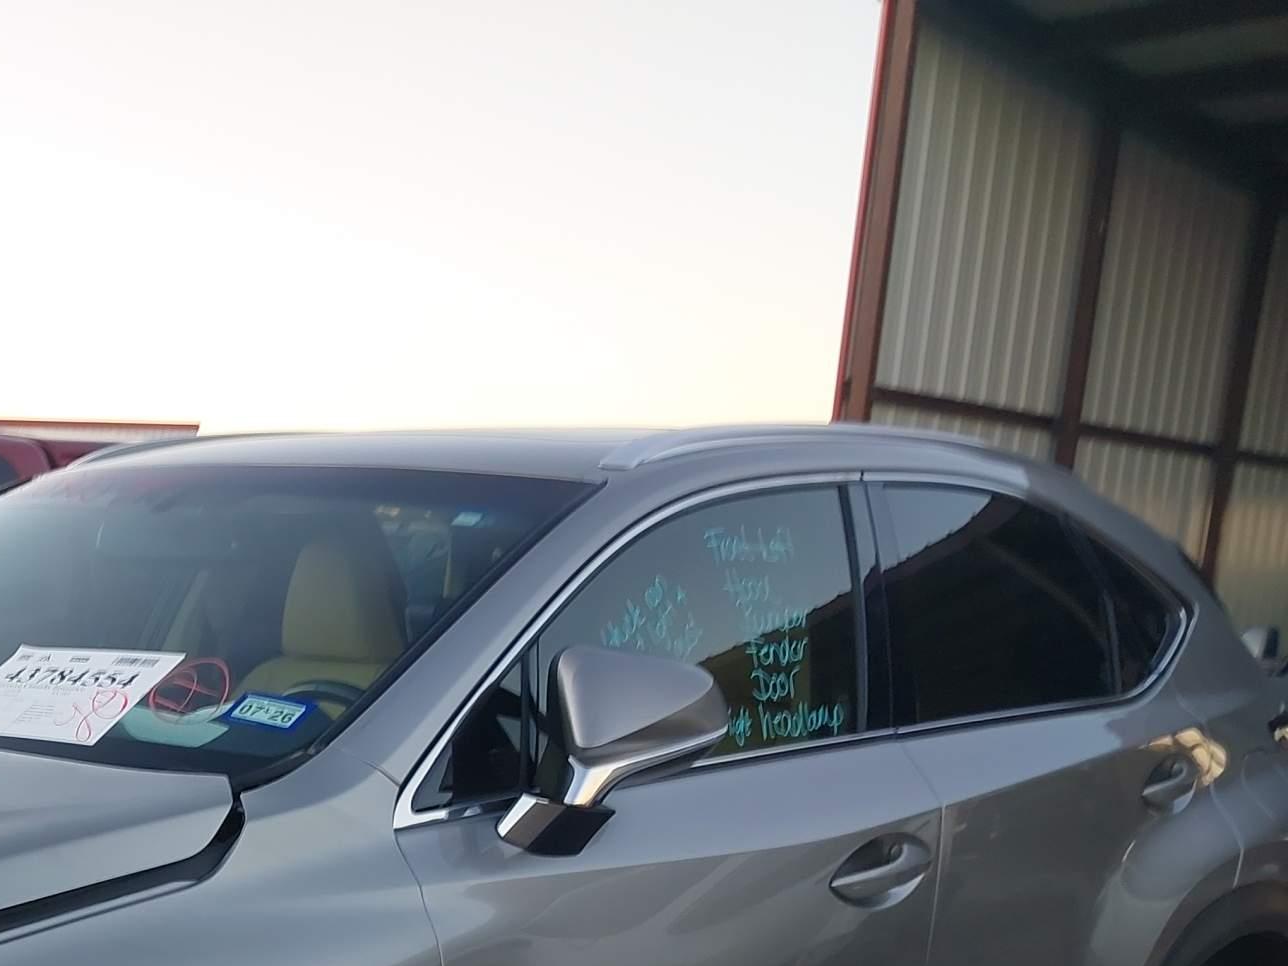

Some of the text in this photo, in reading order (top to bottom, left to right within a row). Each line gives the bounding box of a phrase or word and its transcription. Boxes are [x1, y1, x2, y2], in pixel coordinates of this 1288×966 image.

[745, 635, 809, 668] Fender
[4, 664, 142, 690] 43784554
[750, 665, 801, 702] Door
[758, 700, 845, 742] headlamp
